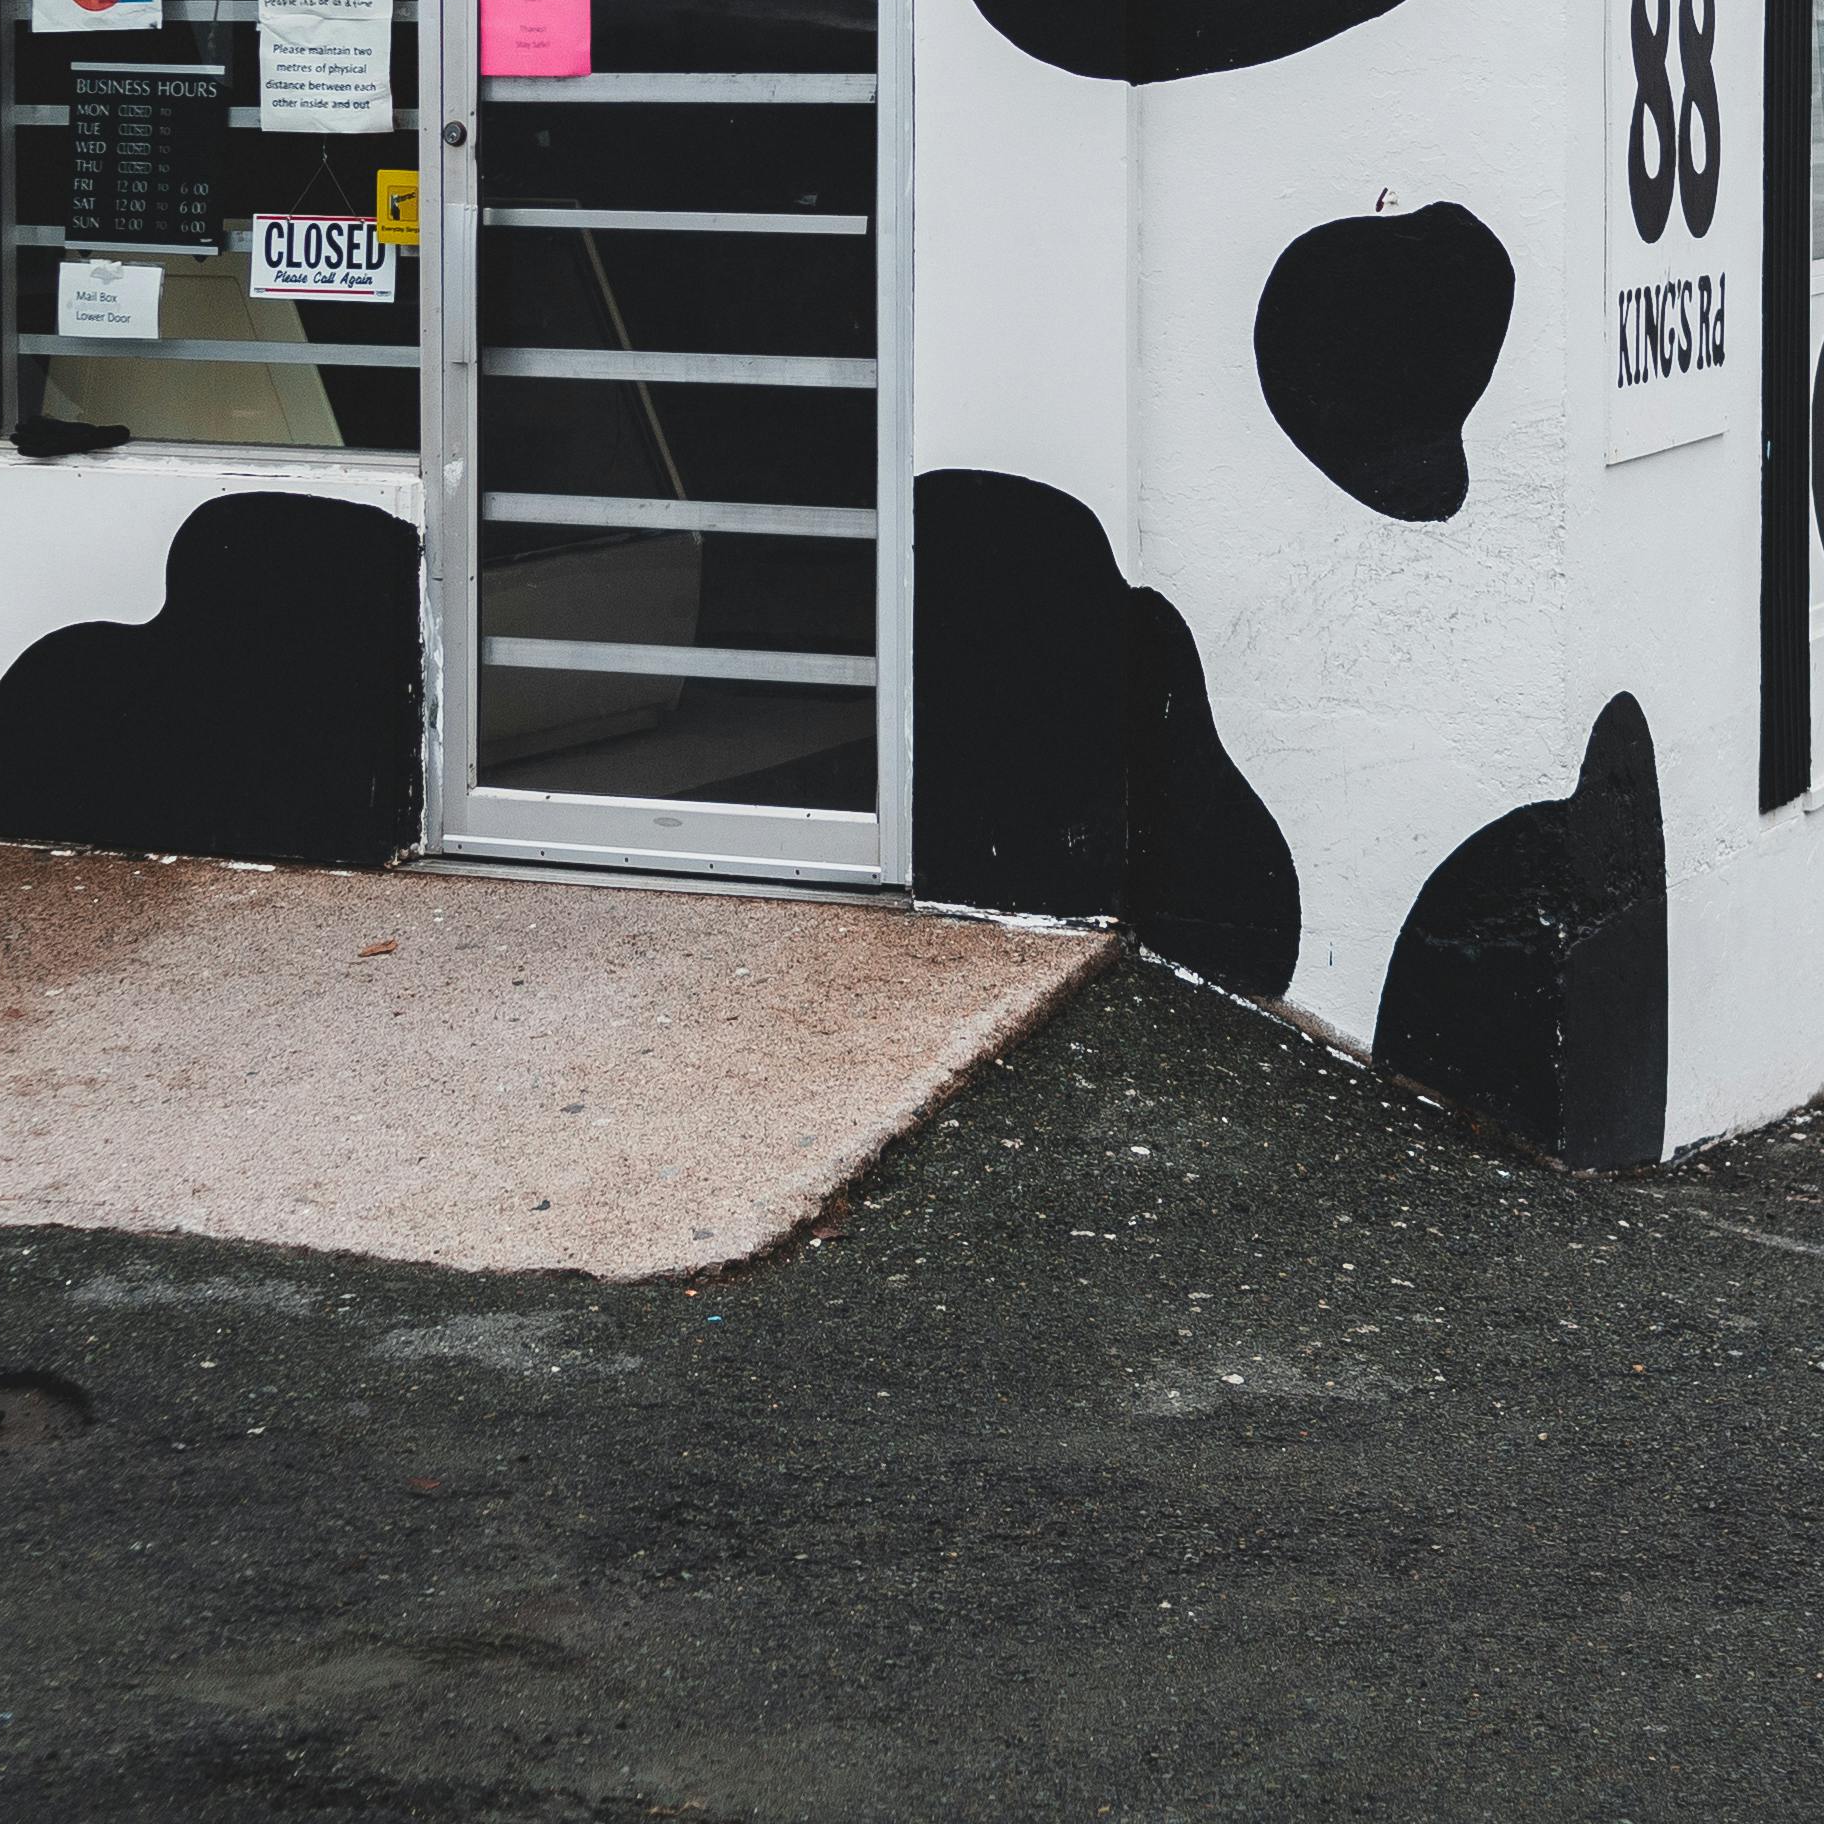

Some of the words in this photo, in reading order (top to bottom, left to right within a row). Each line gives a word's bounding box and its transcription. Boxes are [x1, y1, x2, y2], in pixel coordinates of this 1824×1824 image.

[273, 44, 306, 54] Please
[308, 45, 351, 56] maintain
[354, 47, 373, 56] two
[276, 63, 312, 72] metres
[315, 63, 326, 73] of
[328, 63, 367, 75] physical
[76, 78, 151, 96] BUSINESS
[158, 81, 217, 97] HOURS
[265, 80, 305, 90] distance
[308, 80, 352, 91] between
[354, 82, 376, 91] each
[77, 103, 109, 117] MON
[272, 98, 298, 108] other
[300, 98, 329, 109] inside
[331, 99, 350, 109] and
[352, 100, 371, 110] out
[77, 122, 101, 135] TUE
[76, 141, 107, 154] WED
[75, 160, 103, 173] THU
[73, 178, 93, 191] FRI
[73, 197, 96, 210] SAT
[72, 216, 100, 229] SUN
[265, 222, 385, 270] CLOSED
[274, 270, 308, 283] Please
[313, 271, 335, 284] Call
[340, 273, 373, 288] Again
[76, 291, 97, 302] Mail
[99, 292, 117, 303] Box
[76, 311, 106, 321] Lower
[108, 312, 131, 323] Door
[1618, 278, 1693, 389] KING'S
[1697, 272, 1726, 370] Rd
